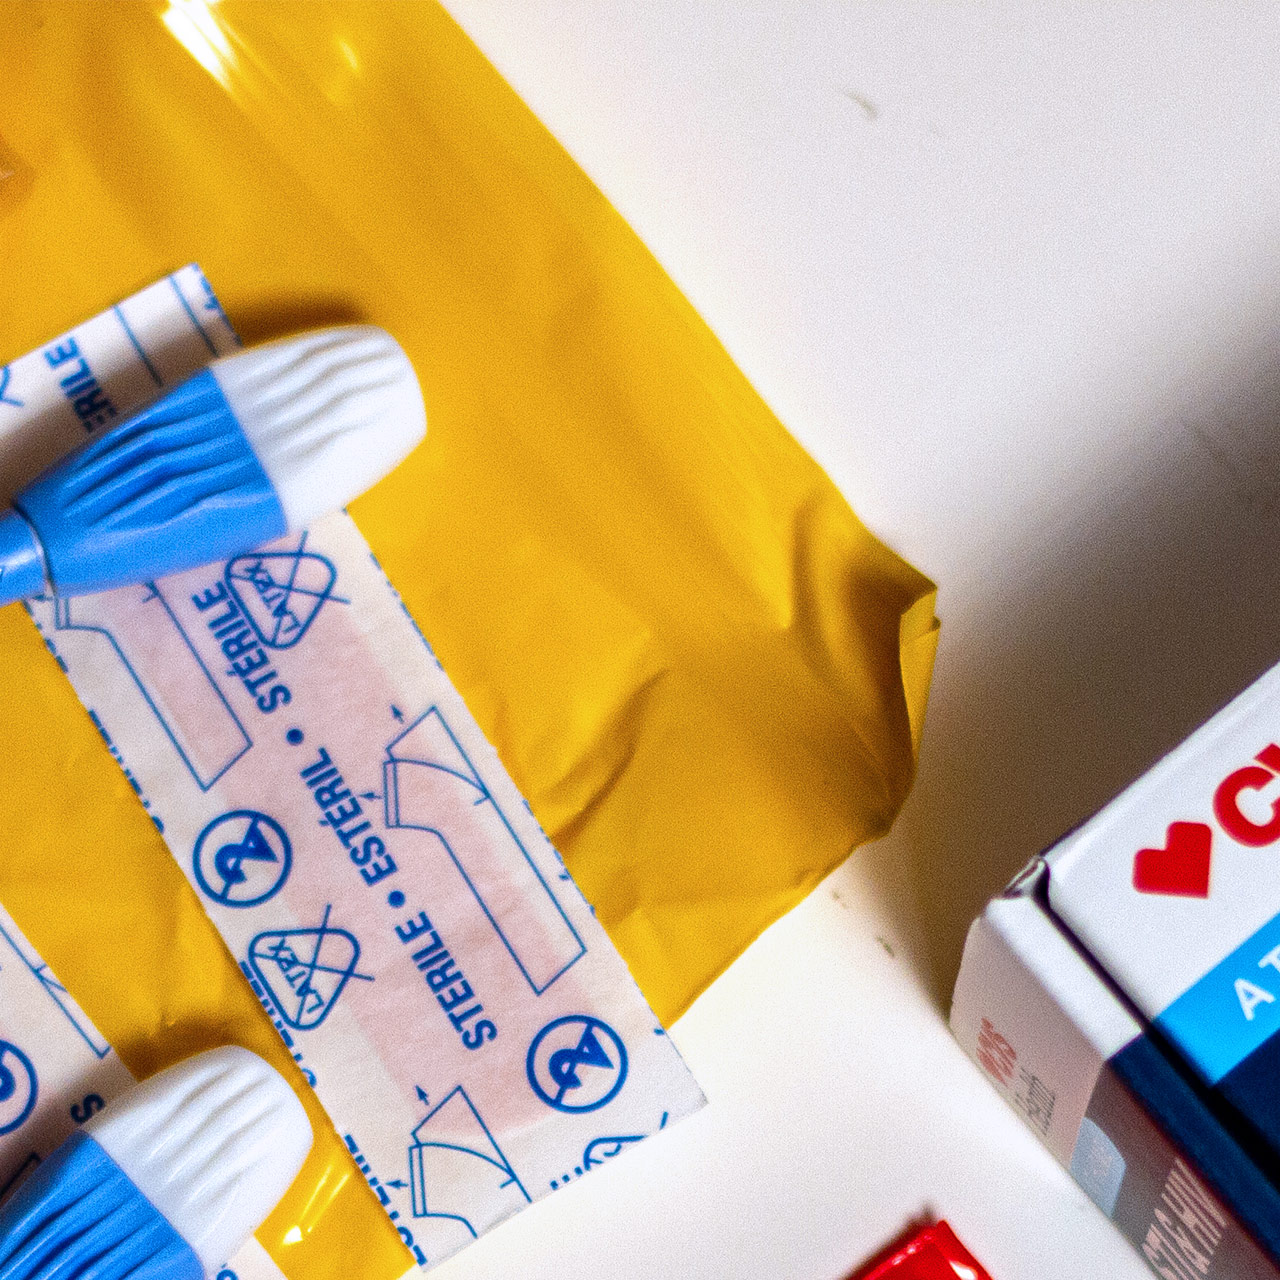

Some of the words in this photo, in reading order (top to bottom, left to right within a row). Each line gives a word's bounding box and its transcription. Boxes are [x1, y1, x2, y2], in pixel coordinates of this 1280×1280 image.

[299, 747, 398, 886] ESTÉRIL
[395, 911, 498, 1052] STERILE
[1152, 1208, 1211, 1275] &
[1161, 1162, 1229, 1254] HIV
